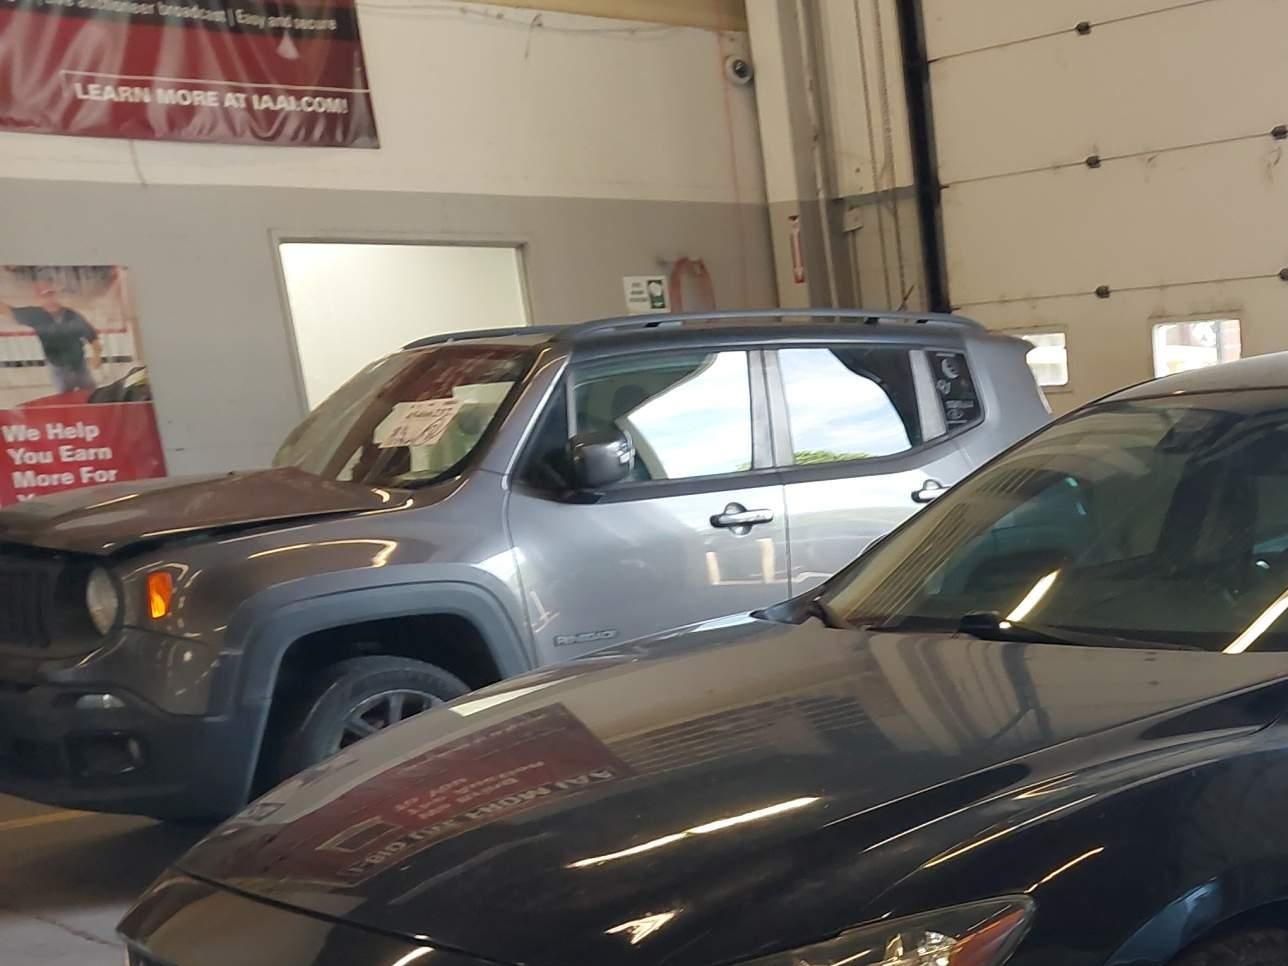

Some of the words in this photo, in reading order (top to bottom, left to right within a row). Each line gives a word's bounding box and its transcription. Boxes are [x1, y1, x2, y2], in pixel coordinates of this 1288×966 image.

[74, 83, 150, 103] LEARN
[156, 88, 219, 107] MORE
[223, 92, 247, 109] AT
[2, 425, 41, 443] We
[47, 421, 99, 442] Help
[8, 448, 53, 465] You
[60, 445, 112, 462] Earn
[13, 471, 75, 488] More
[80, 467, 118, 482] For
